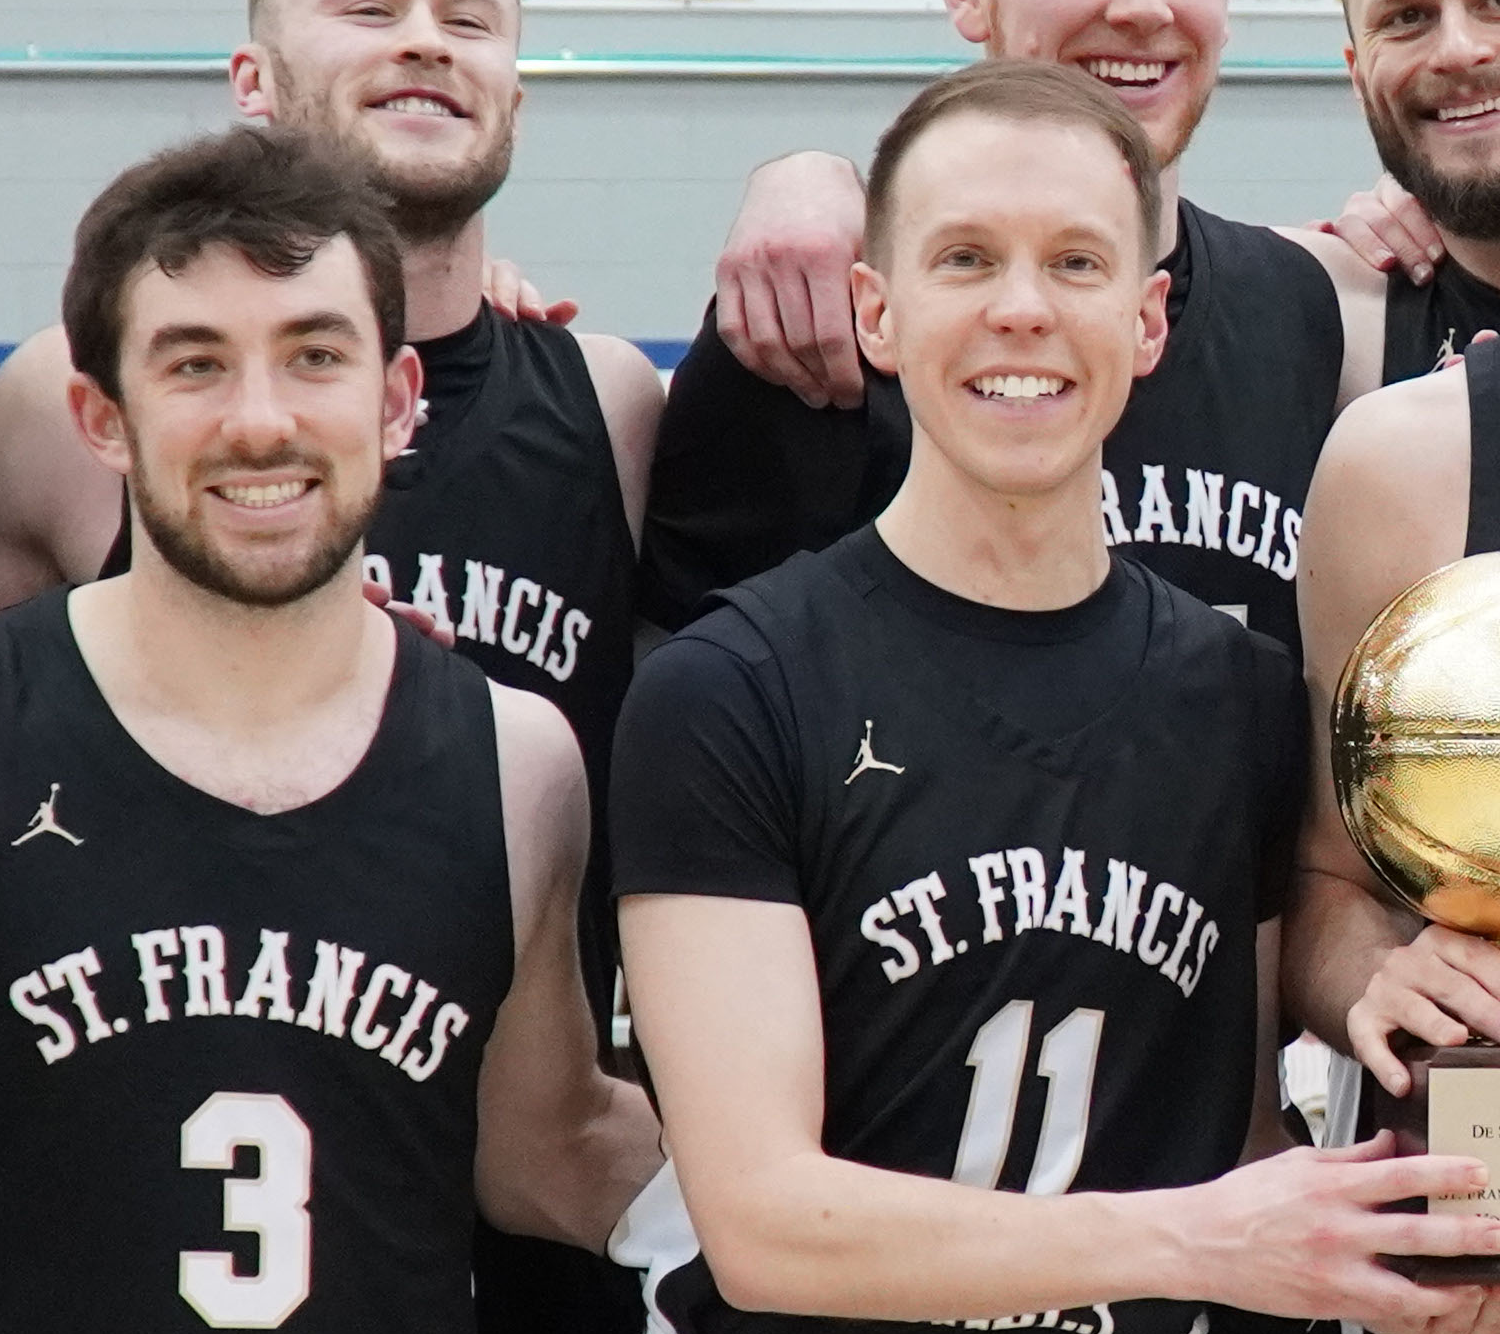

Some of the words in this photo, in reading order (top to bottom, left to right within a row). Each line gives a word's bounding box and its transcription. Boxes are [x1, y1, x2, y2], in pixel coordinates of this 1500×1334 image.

[860, 873, 968, 984] ST.
[969, 846, 1220, 998] FRANCIS
[9, 947, 129, 1065] ST.
[131, 924, 469, 1082] FRANCIS
[952, 999, 1105, 1195] 11
[1472, 1125, 1494, 1139] DE
[178, 1091, 312, 1330] 3
